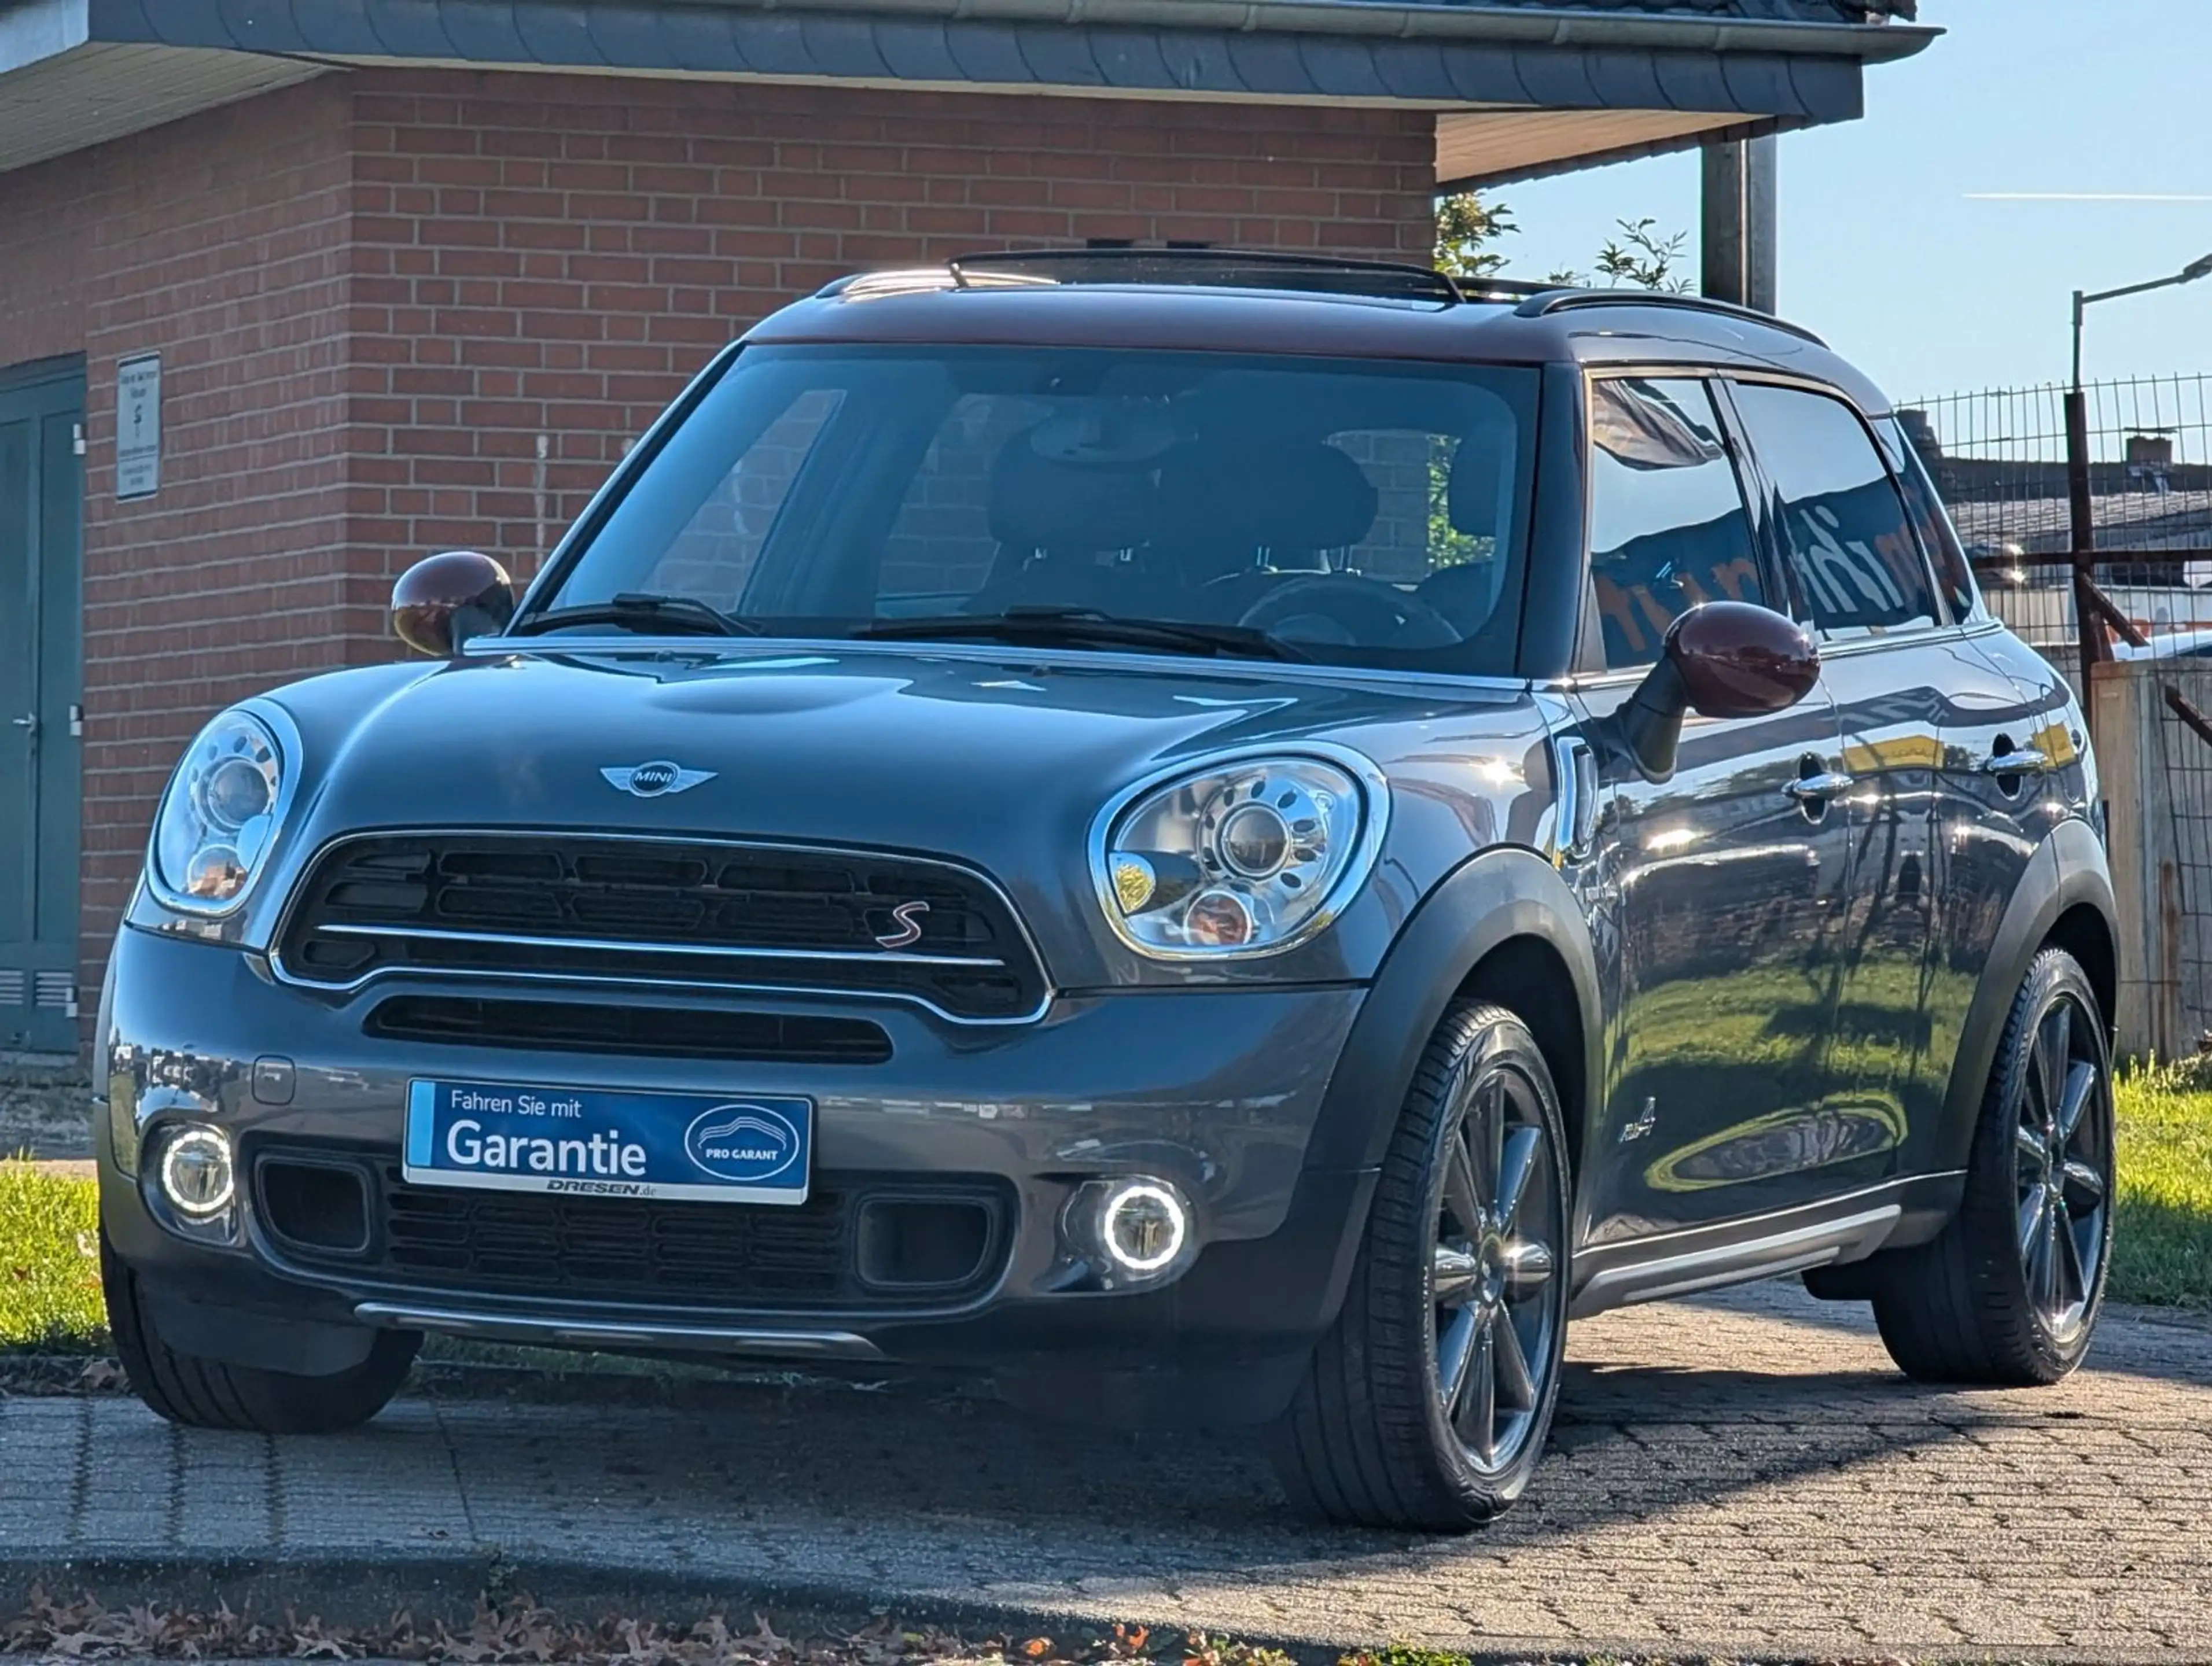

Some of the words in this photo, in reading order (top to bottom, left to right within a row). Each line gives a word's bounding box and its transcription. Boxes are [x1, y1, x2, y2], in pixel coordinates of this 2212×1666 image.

[634, 771, 673, 783] MINI
[874, 900, 930, 949] S
[451, 1089, 513, 1114] Fahren
[517, 1094, 546, 1116] Sie
[551, 1099, 583, 1118] mit
[446, 1119, 647, 1177] Garantie
[705, 1148, 730, 1160] PRO
